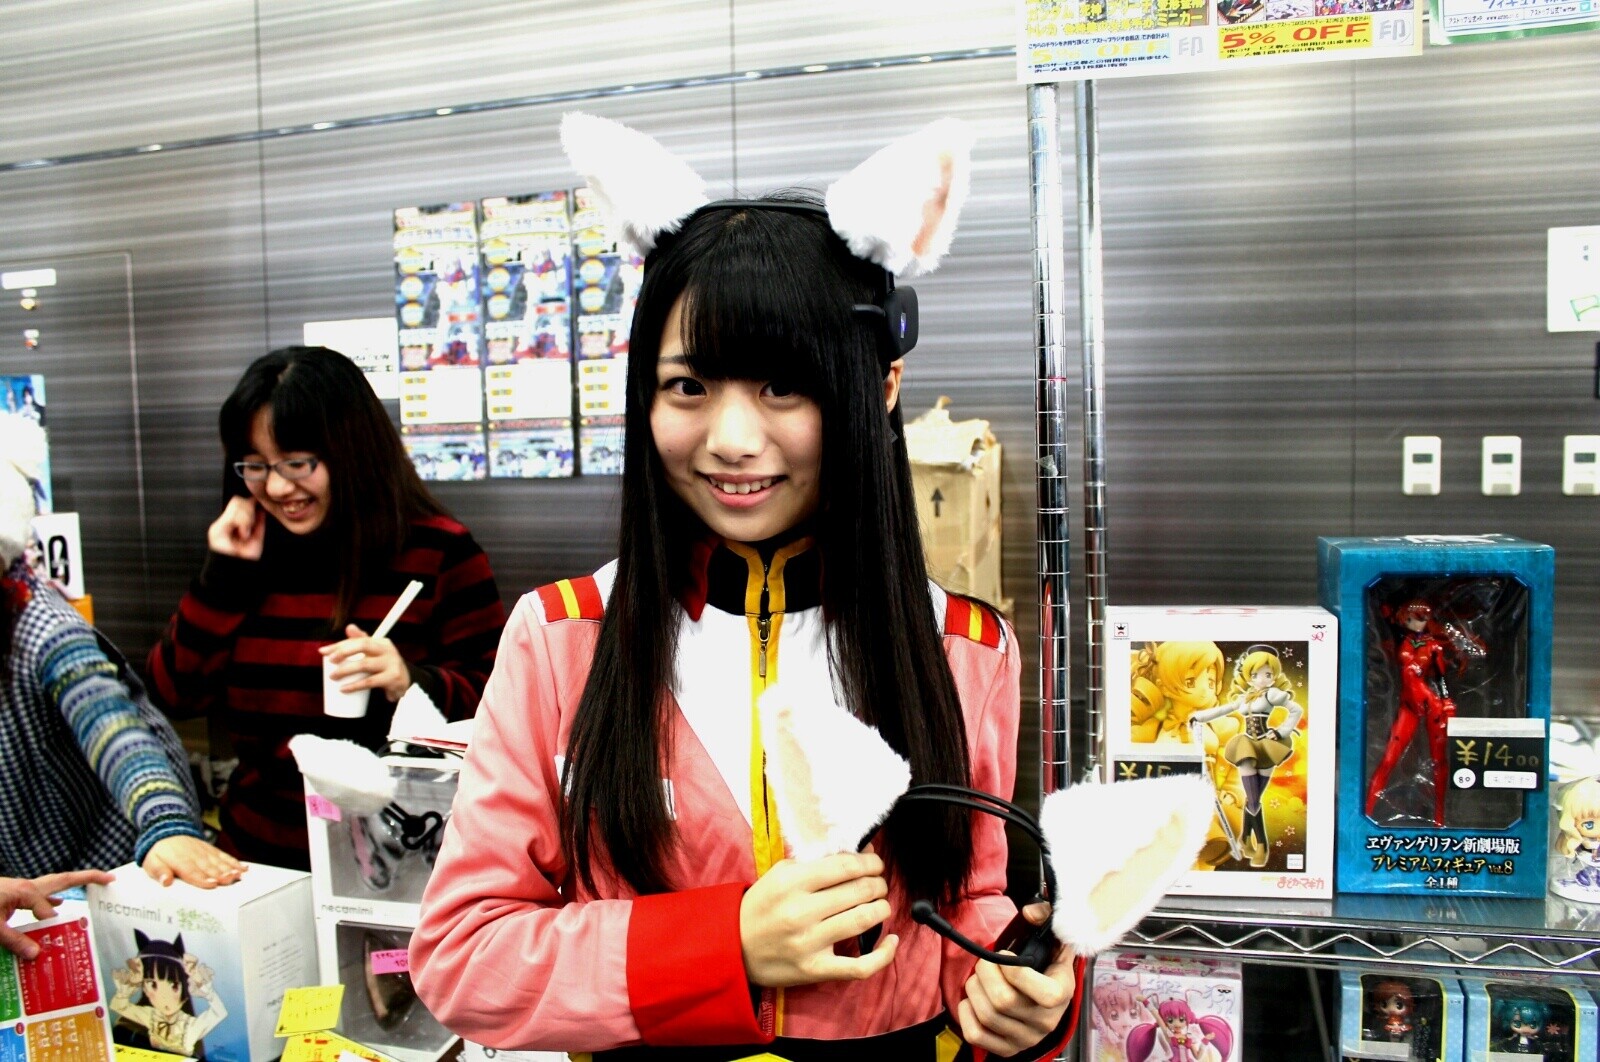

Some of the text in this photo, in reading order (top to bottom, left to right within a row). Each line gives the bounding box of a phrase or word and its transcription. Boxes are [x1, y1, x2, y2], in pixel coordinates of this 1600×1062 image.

[1157, 11, 1203, 27] ミニカー
[1223, 22, 1369, 49] 5% OFF
[1378, 19, 1405, 41] 印
[1032, 40, 1169, 64] 5% OFF
[1178, 36, 1203, 56] 印
[1455, 739, 1541, 767] ¥1400
[1373, 855, 1487, 875] プレミアムフィギュア
[1426, 876, 1458, 889] 全1種
